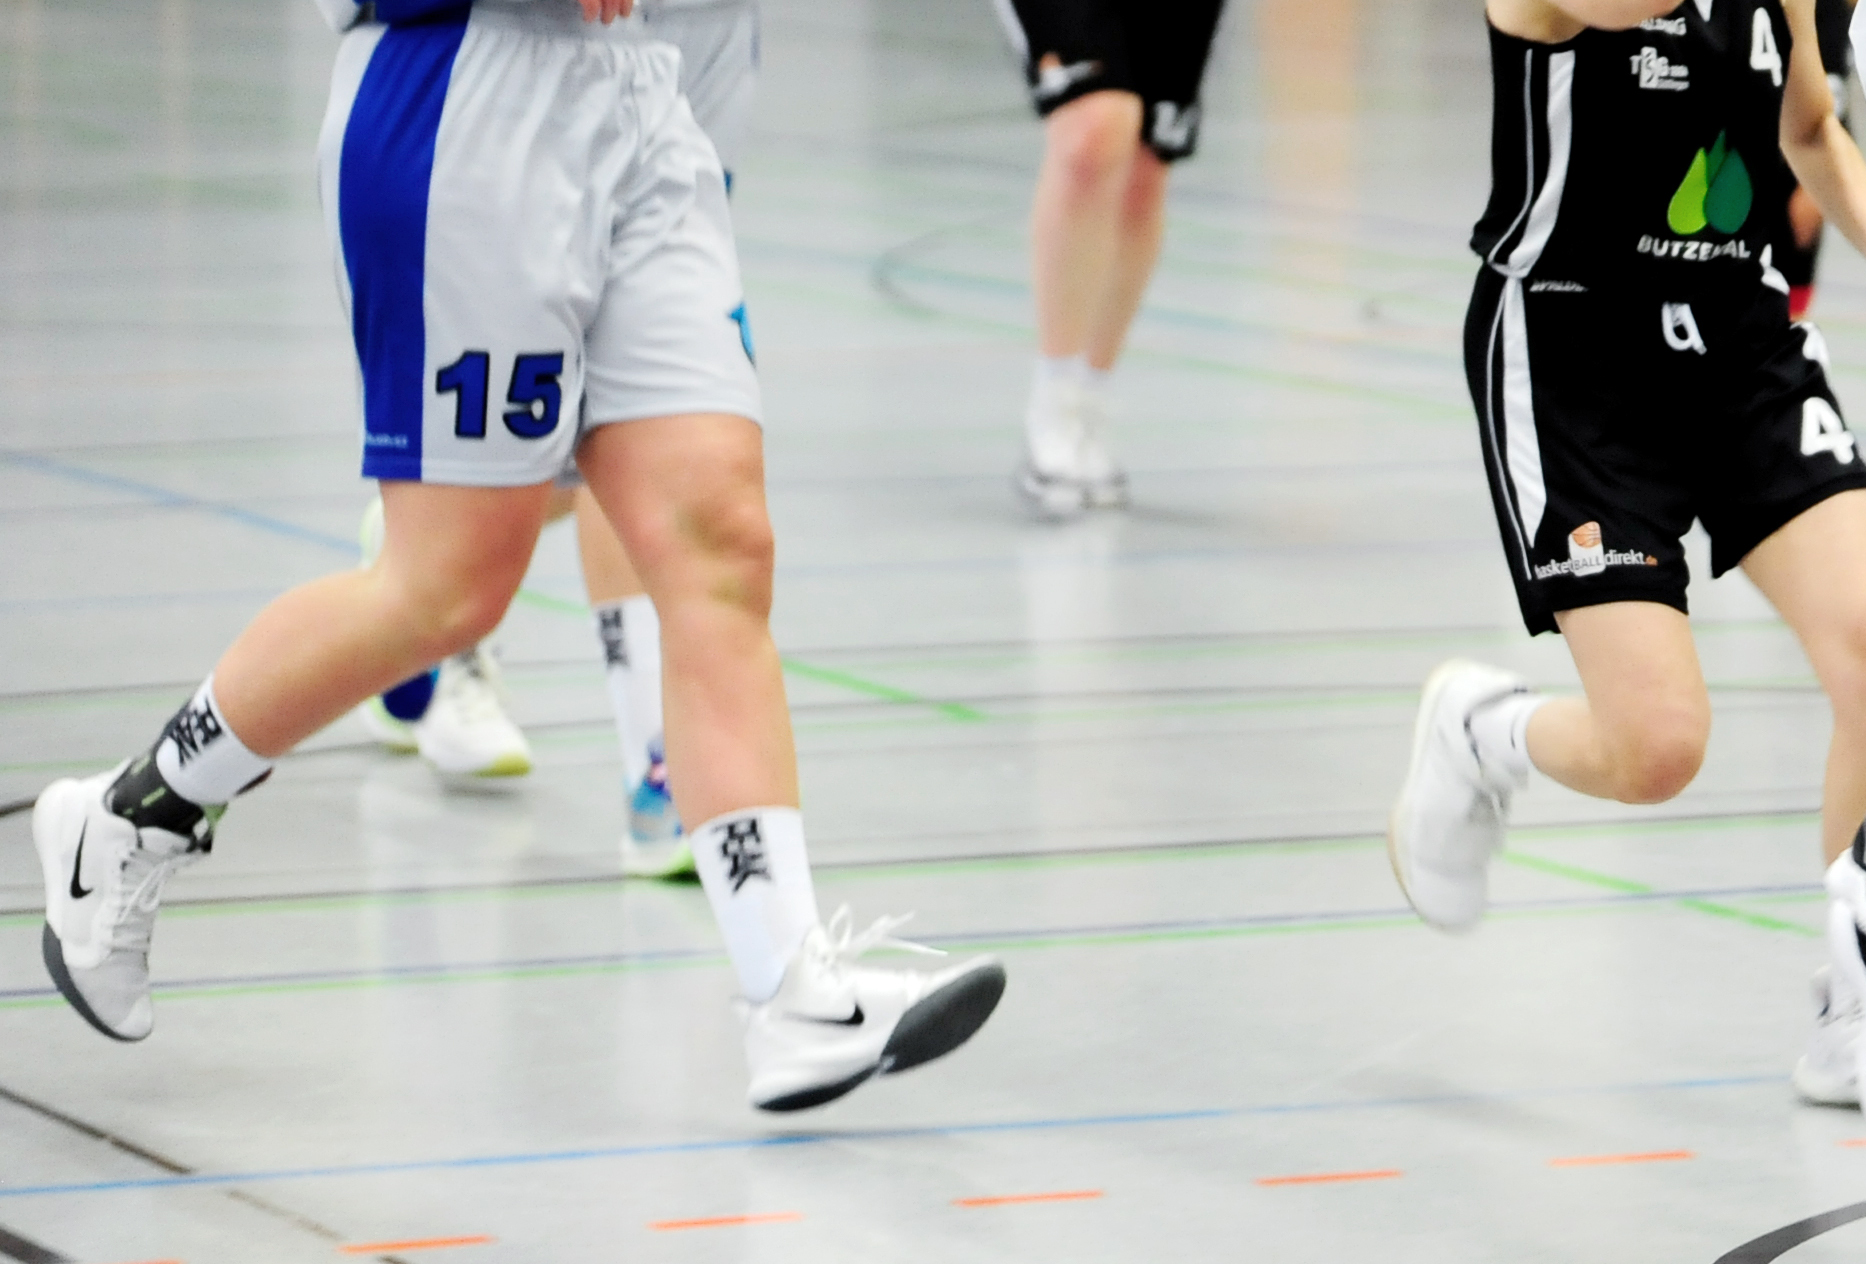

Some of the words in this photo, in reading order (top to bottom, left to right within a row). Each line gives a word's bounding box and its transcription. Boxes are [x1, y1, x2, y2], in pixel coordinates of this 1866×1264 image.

[1750, 7, 1783, 87] 4
[436, 350, 564, 440] 15
[1801, 396, 1854, 464] 4
